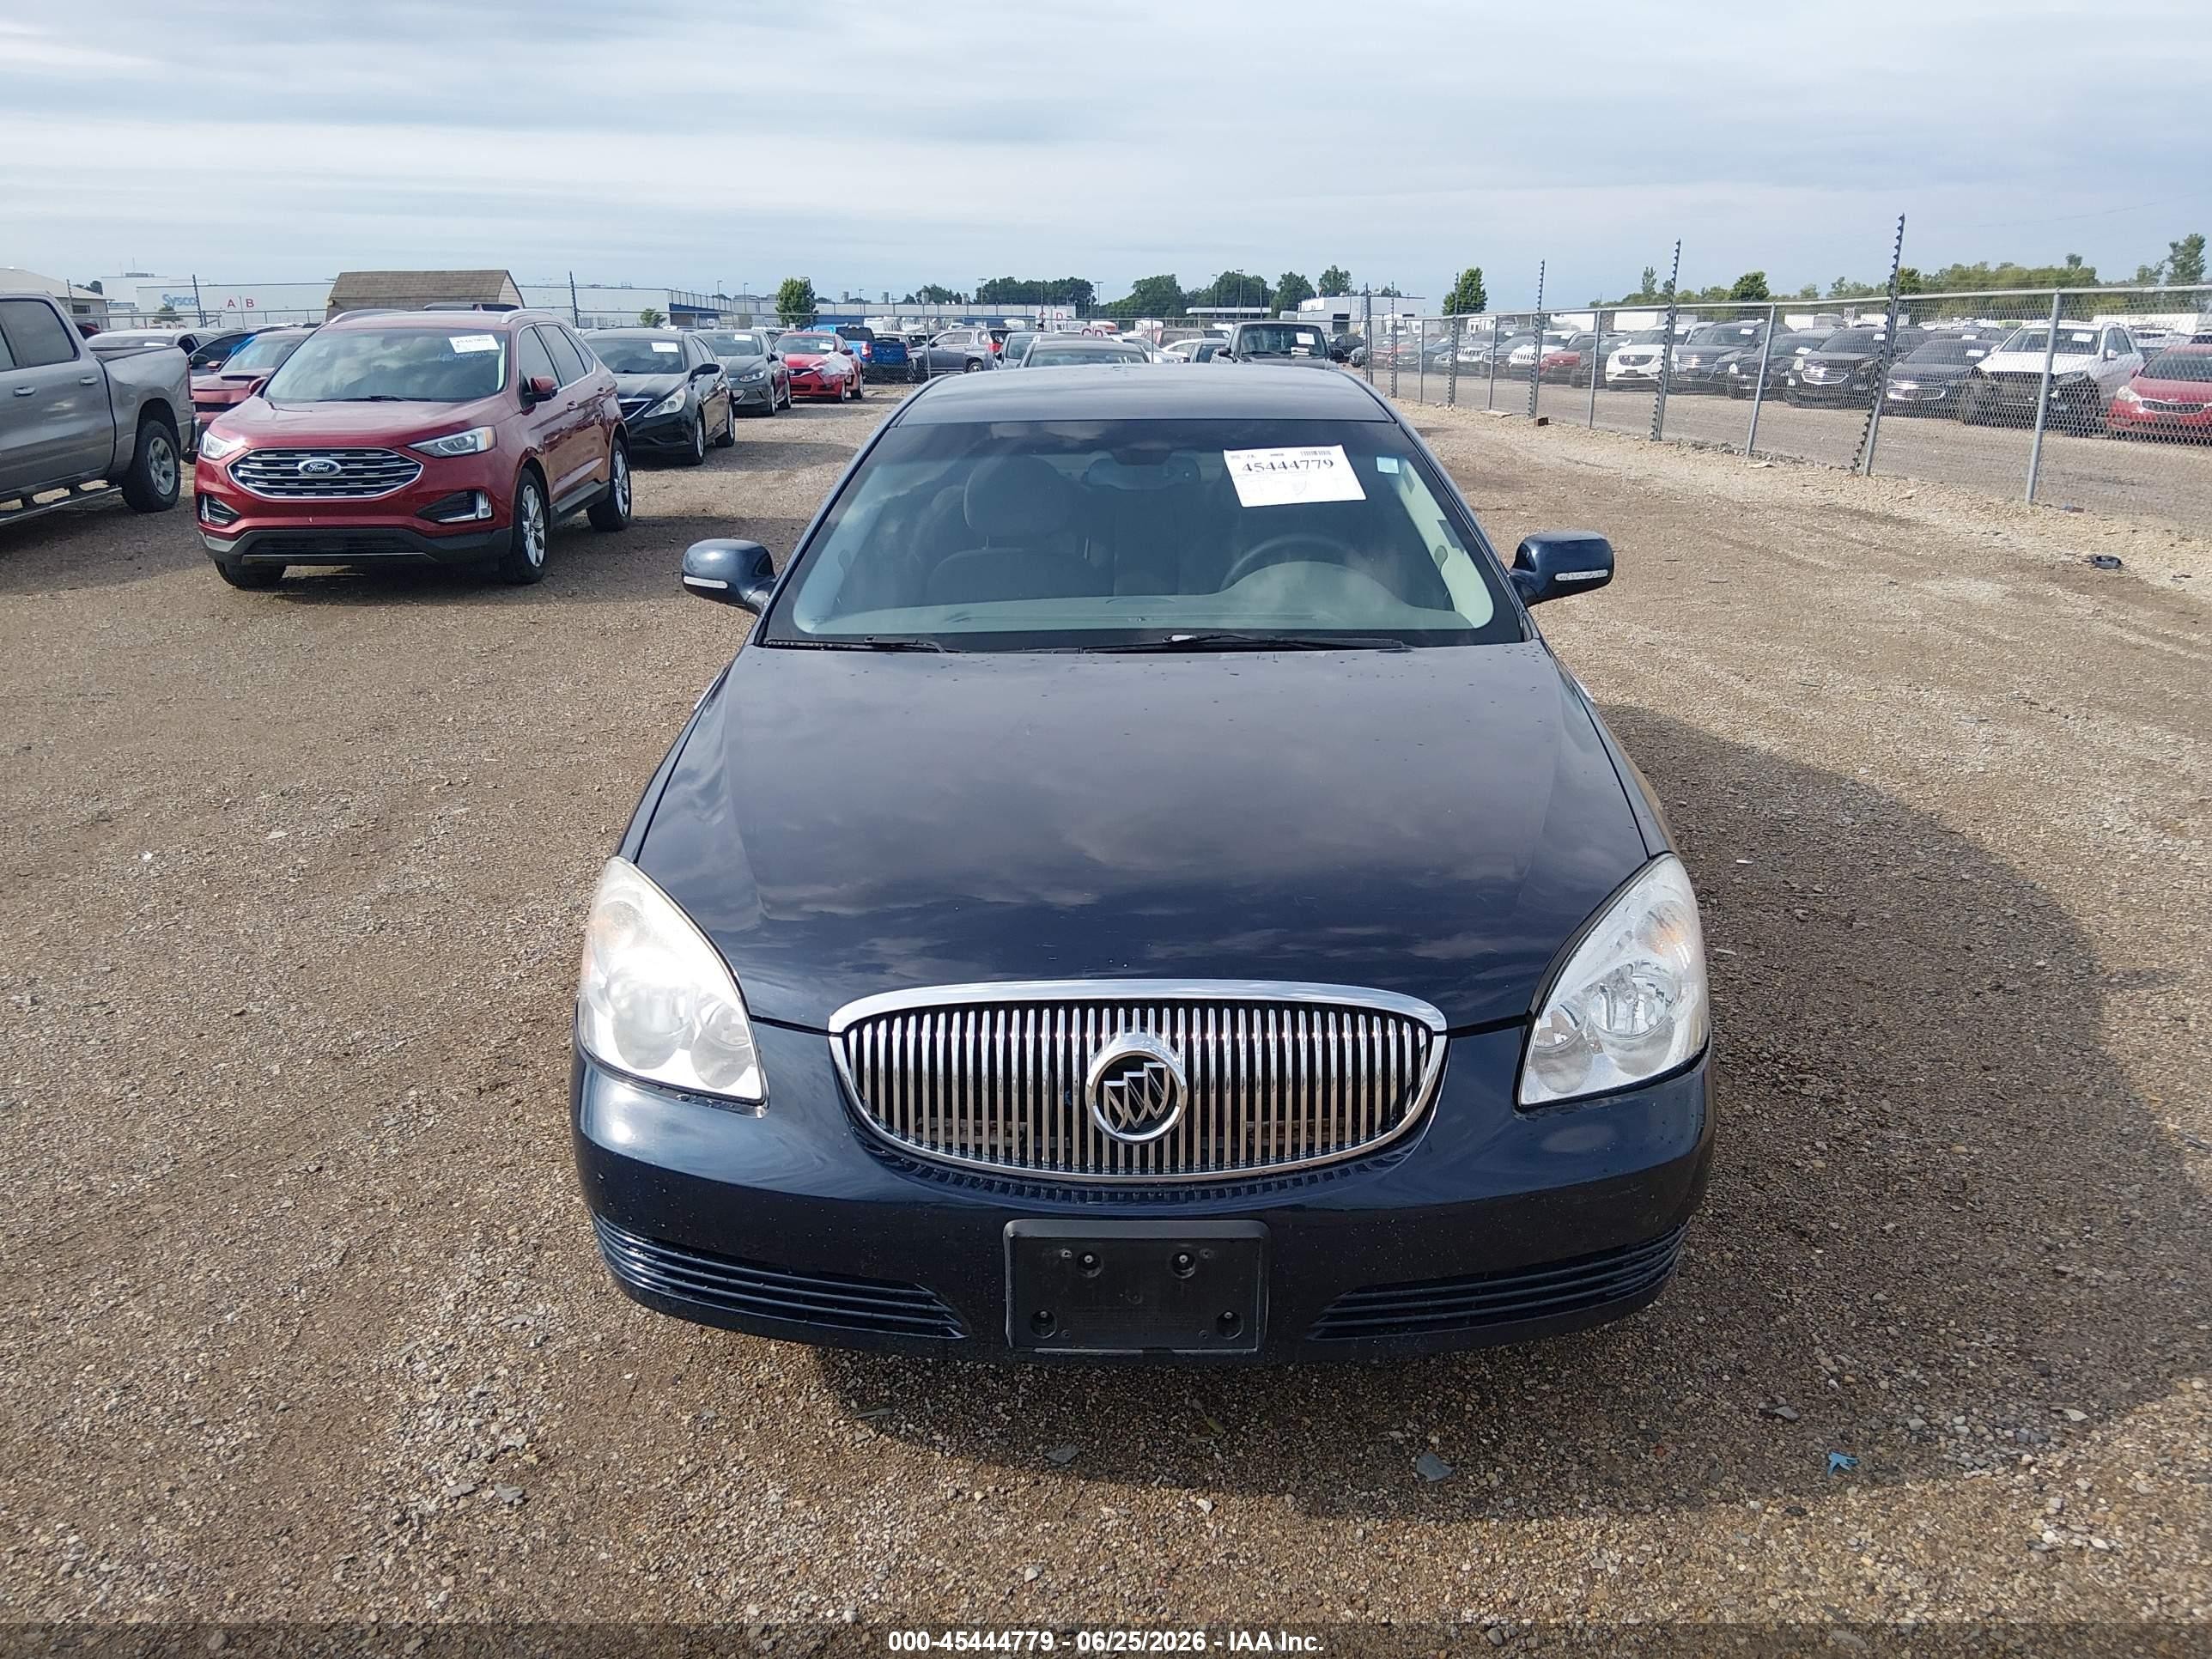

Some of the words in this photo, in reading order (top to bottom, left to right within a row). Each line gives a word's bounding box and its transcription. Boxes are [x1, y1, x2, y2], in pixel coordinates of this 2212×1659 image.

[161, 294, 198, 307] Sysco
[227, 299, 236, 308] A
[246, 298, 255, 307] B
[307, 463, 330, 474] Ford
[1242, 459, 1334, 472] 45444779
